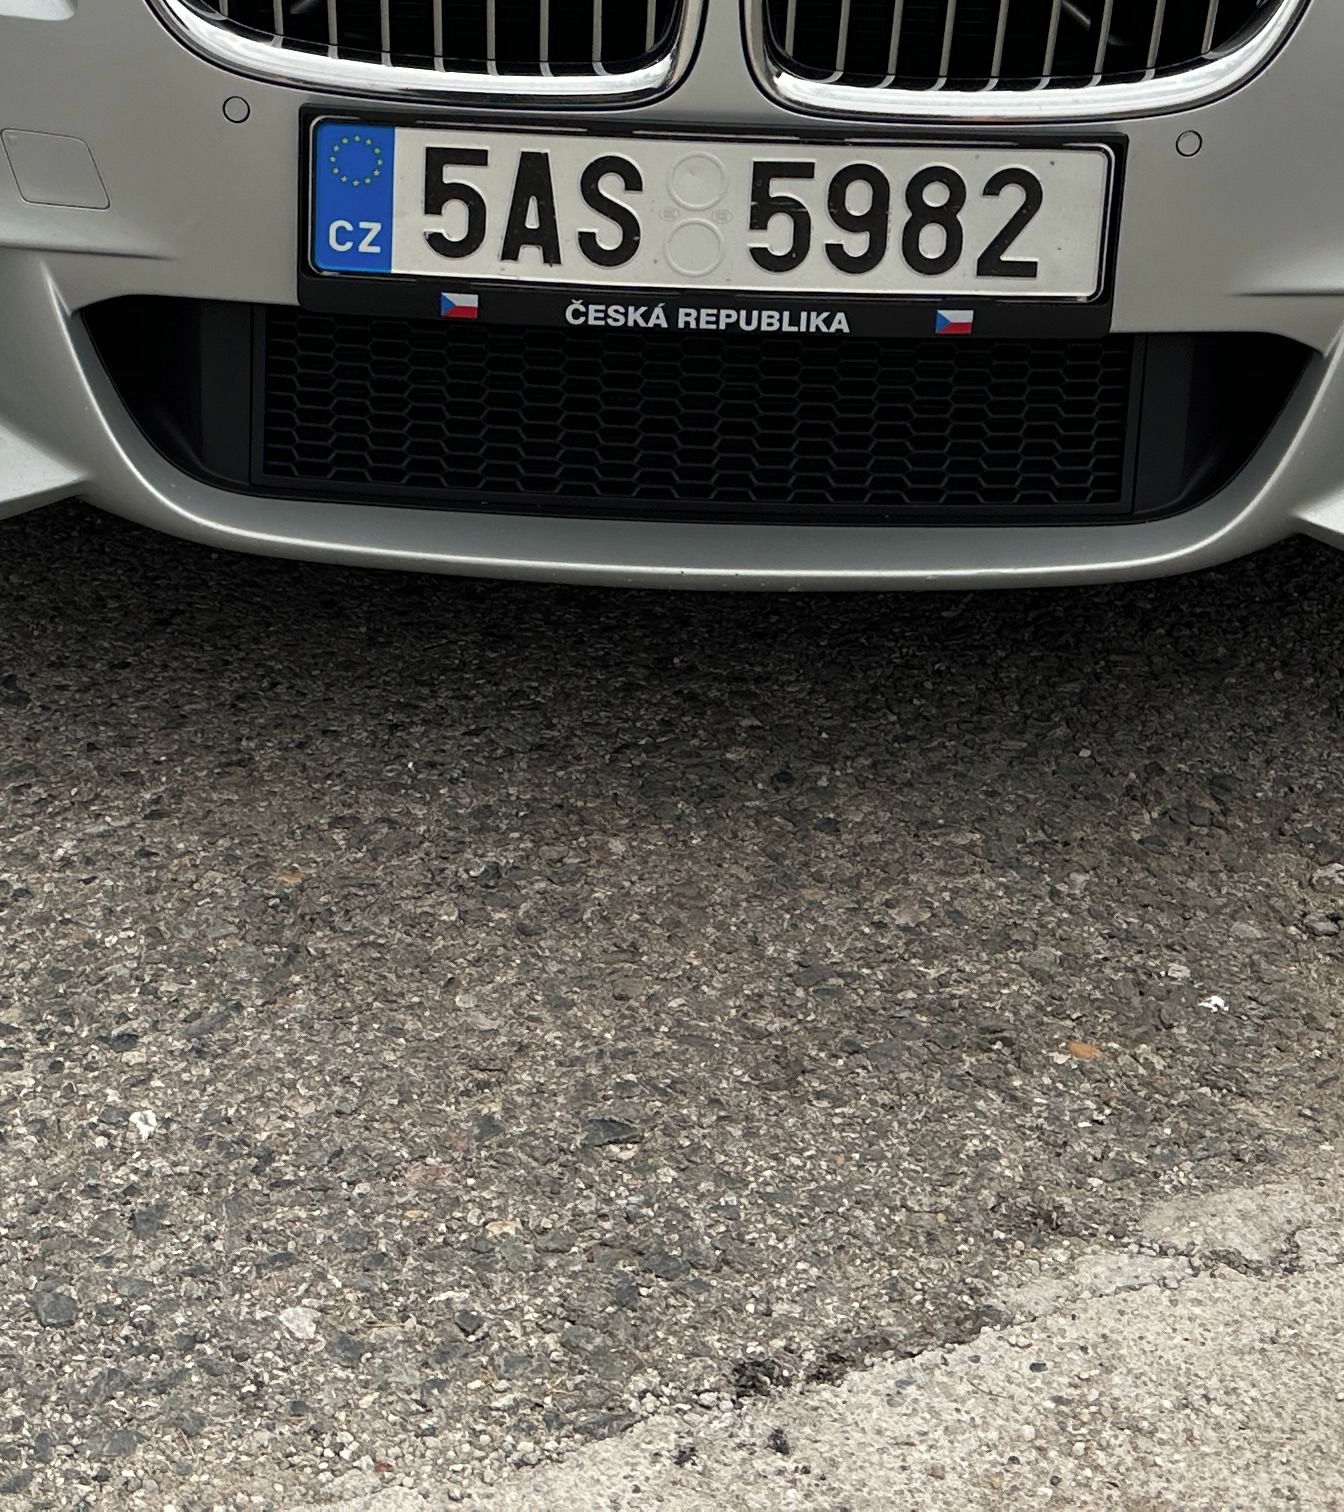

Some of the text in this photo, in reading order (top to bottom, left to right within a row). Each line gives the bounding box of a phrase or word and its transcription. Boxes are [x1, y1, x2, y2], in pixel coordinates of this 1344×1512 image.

[329, 145, 1044, 280] CZ 5AS 5982
[564, 299, 850, 333] ČESKÁ REPUBLIKA
